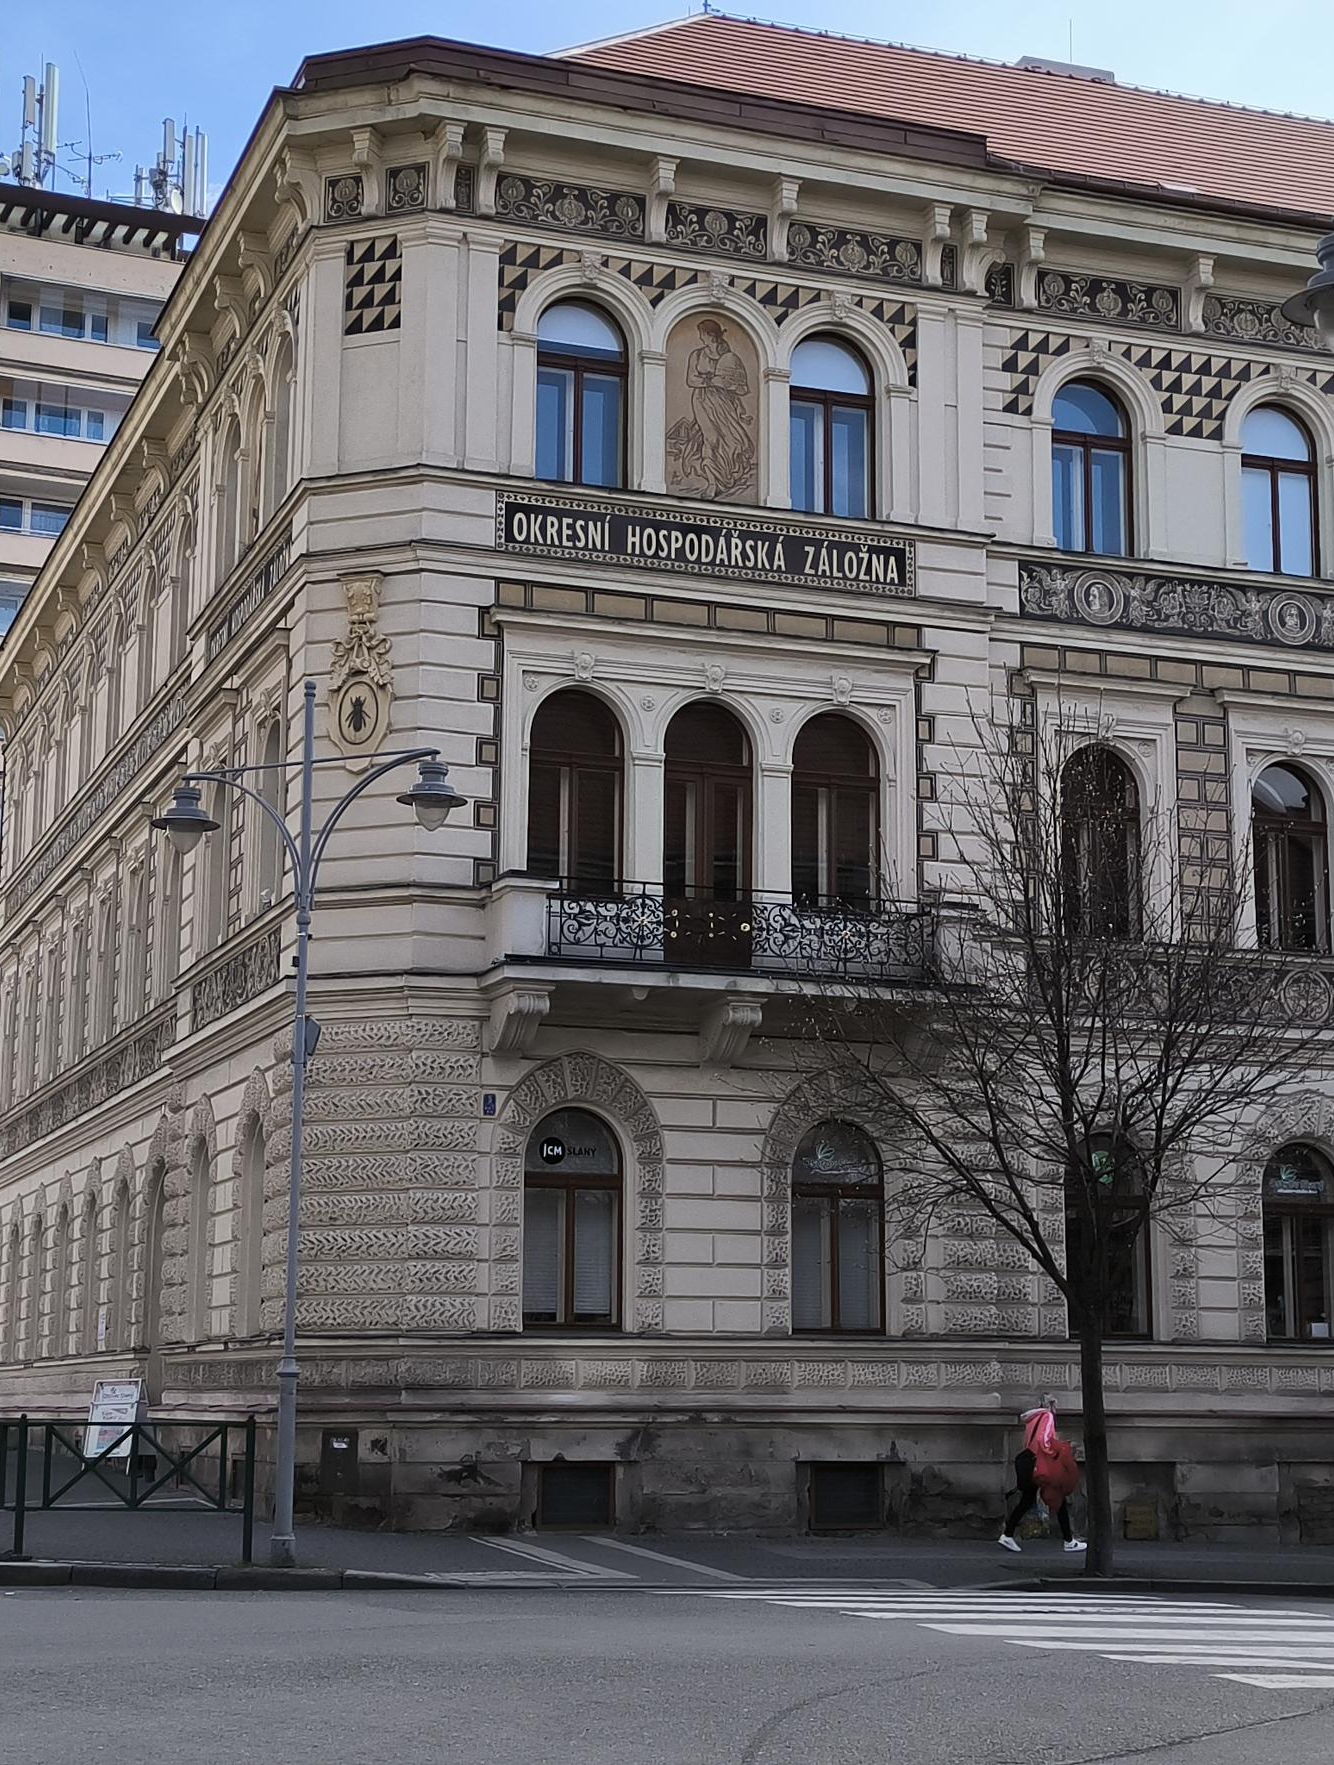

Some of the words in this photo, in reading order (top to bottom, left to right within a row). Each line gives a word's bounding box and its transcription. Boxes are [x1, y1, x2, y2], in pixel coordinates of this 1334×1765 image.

[511, 511, 611, 552] OKRESNÍ
[626, 524, 786, 572] HOSPODÁŘSKÁ
[803, 544, 900, 584] ZÁLOŽNA
